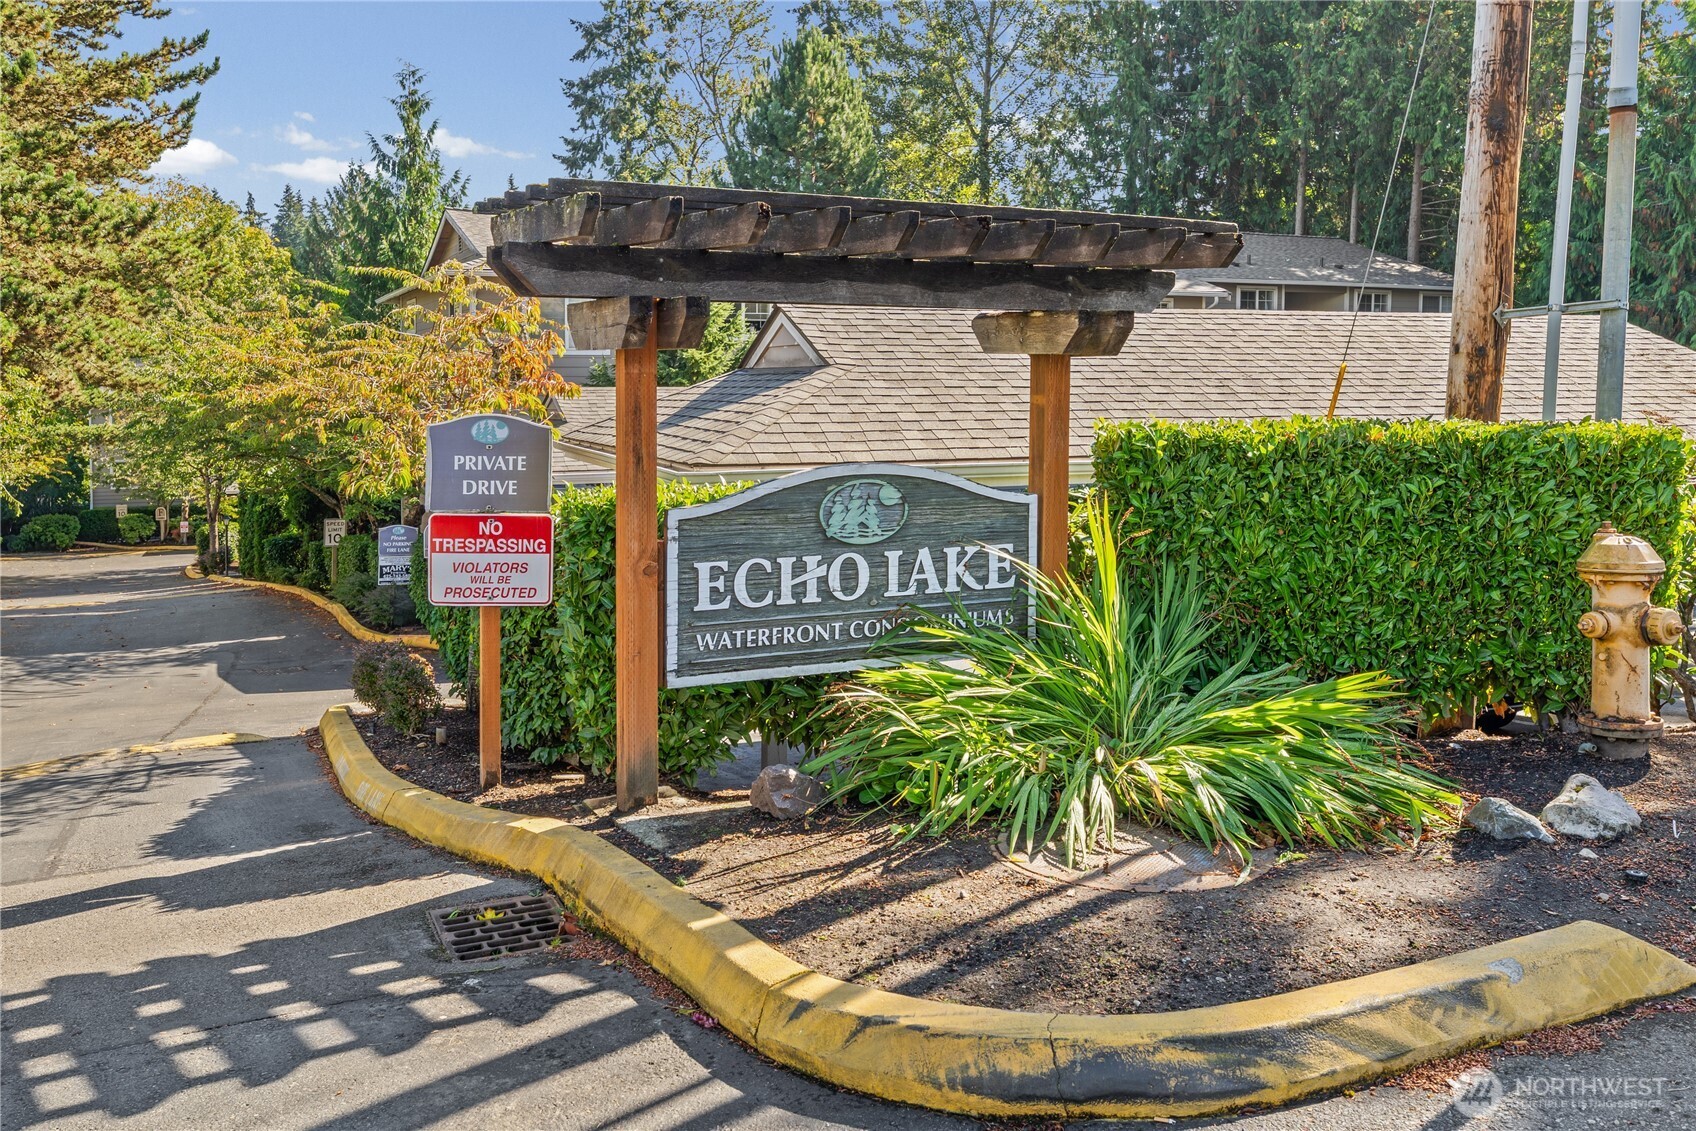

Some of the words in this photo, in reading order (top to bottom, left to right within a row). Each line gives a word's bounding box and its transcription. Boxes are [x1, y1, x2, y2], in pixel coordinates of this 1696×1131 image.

[453, 455, 527, 471] PRIVATE
[462, 480, 518, 495] DRIVE
[478, 521, 503, 535] NO
[432, 538, 547, 553] TRESPASSING
[452, 562, 529, 574] VIOLATORS
[470, 575, 495, 584] WILL
[497, 575, 512, 584] BE
[692, 552, 871, 612] ECHO
[883, 543, 1017, 598] LAKE
[443, 587, 538, 599] PROSECUTED
[696, 622, 844, 651] WATERFRONT
[849, 608, 1014, 639] CONINUMS
